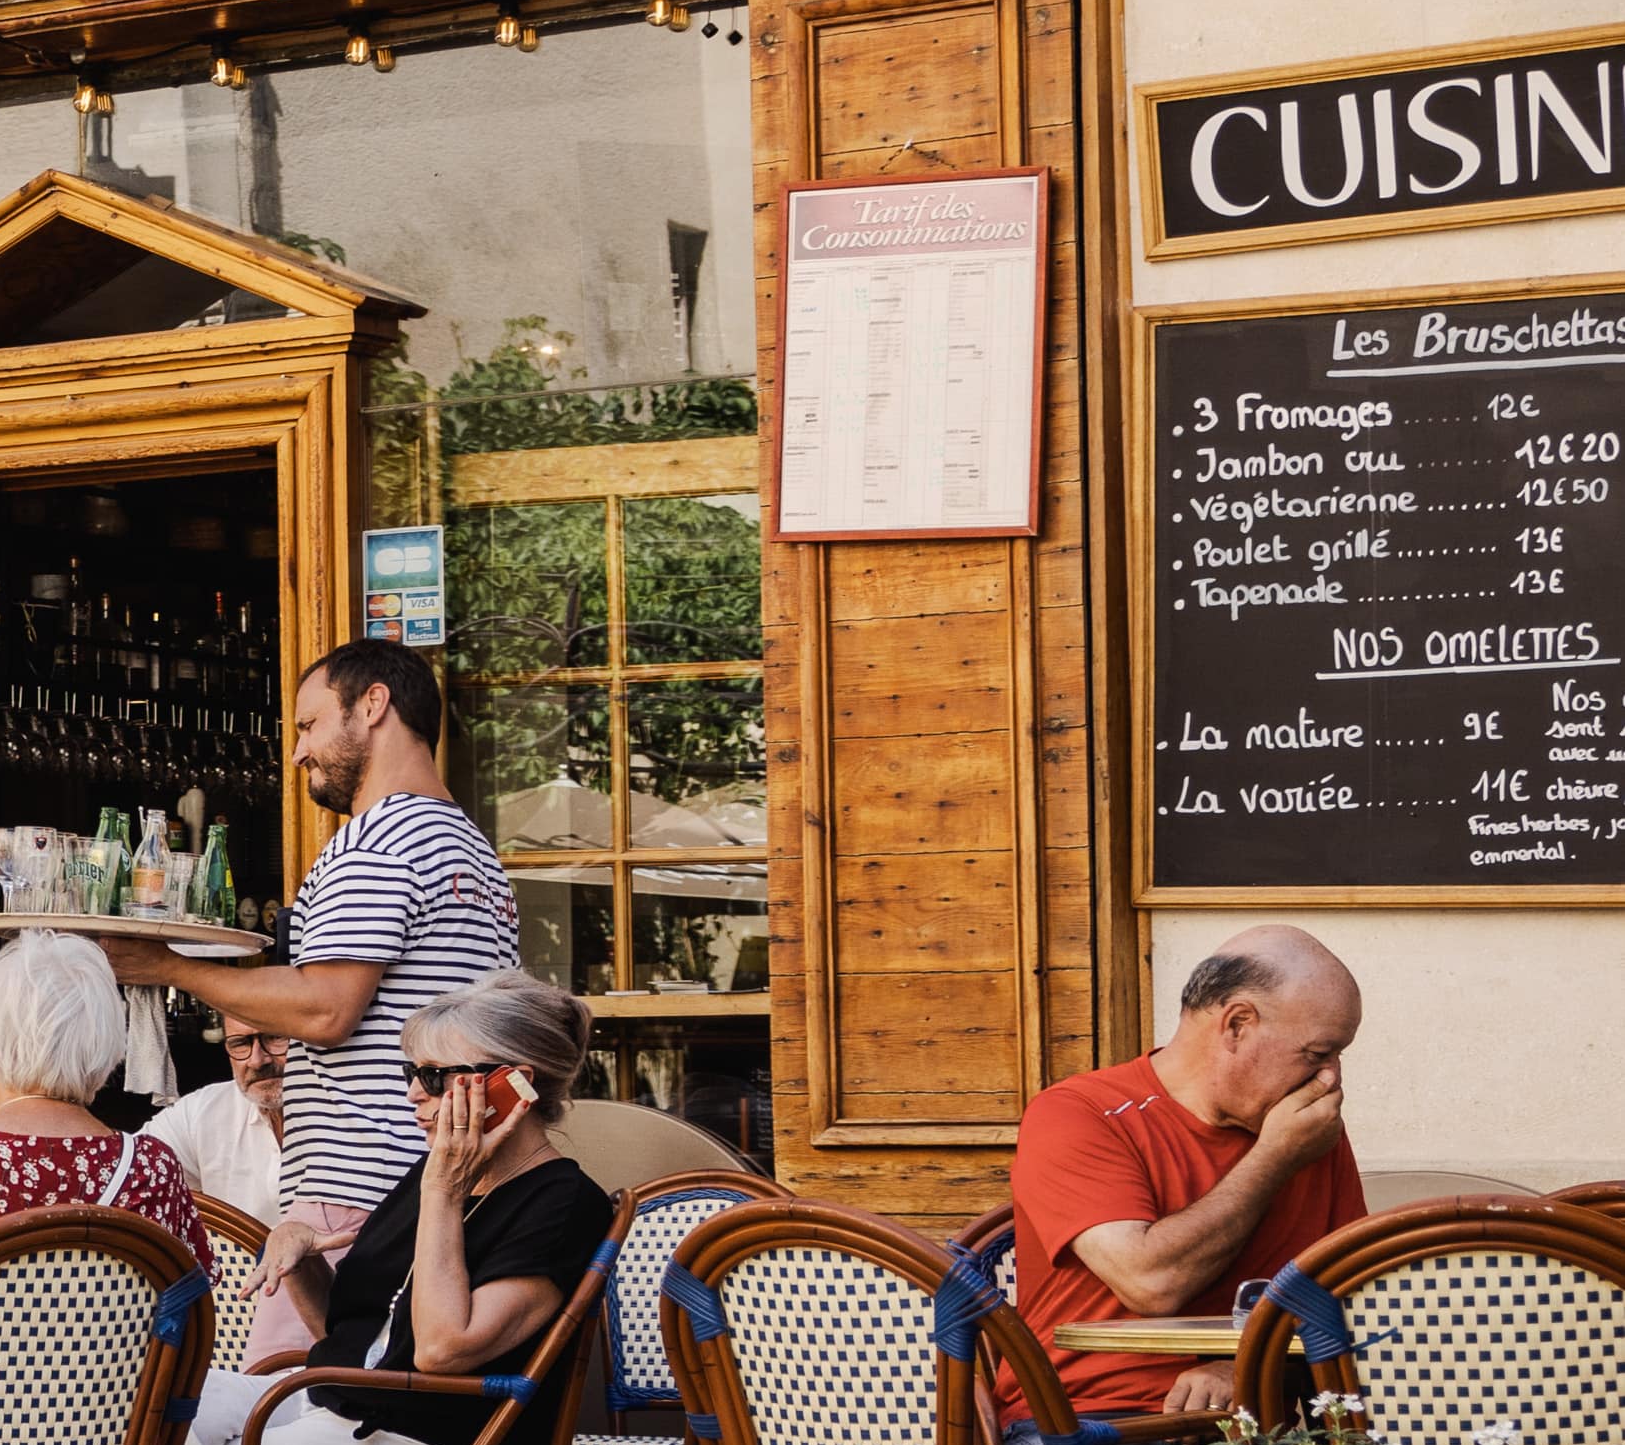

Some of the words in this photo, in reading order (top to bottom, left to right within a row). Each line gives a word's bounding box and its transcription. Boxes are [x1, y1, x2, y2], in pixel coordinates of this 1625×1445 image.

[1188, 60, 1625, 218] CUISIN
[853, 193, 934, 228] Tarif
[931, 193, 976, 220] des
[801, 216, 1027, 250] Consommations
[1332, 319, 1390, 361] Les
[1193, 397, 1219, 433] 3
[1236, 392, 1393, 441] Fromages
[1488, 393, 1540, 423] 12€
[1196, 444, 1324, 482] Jambon
[1193, 534, 1292, 569] Poulet
[1308, 529, 1391, 571] grillé
[1513, 526, 1564, 554] 13€
[410, 598, 436, 609] VISA
[1190, 575, 1348, 621] Tapenade
[1510, 568, 1565, 596] 13€
[1332, 626, 1404, 669] NOS
[1425, 622, 1600, 665] OMELETTES
[1551, 679, 1606, 713] Nos
[1179, 710, 1228, 751] La
[1463, 710, 1504, 742] 9€
[1544, 719, 1606, 739] sont
[1174, 775, 1226, 814] La
[1239, 773, 1360, 814] variée
[1470, 768, 1531, 803] 11€
